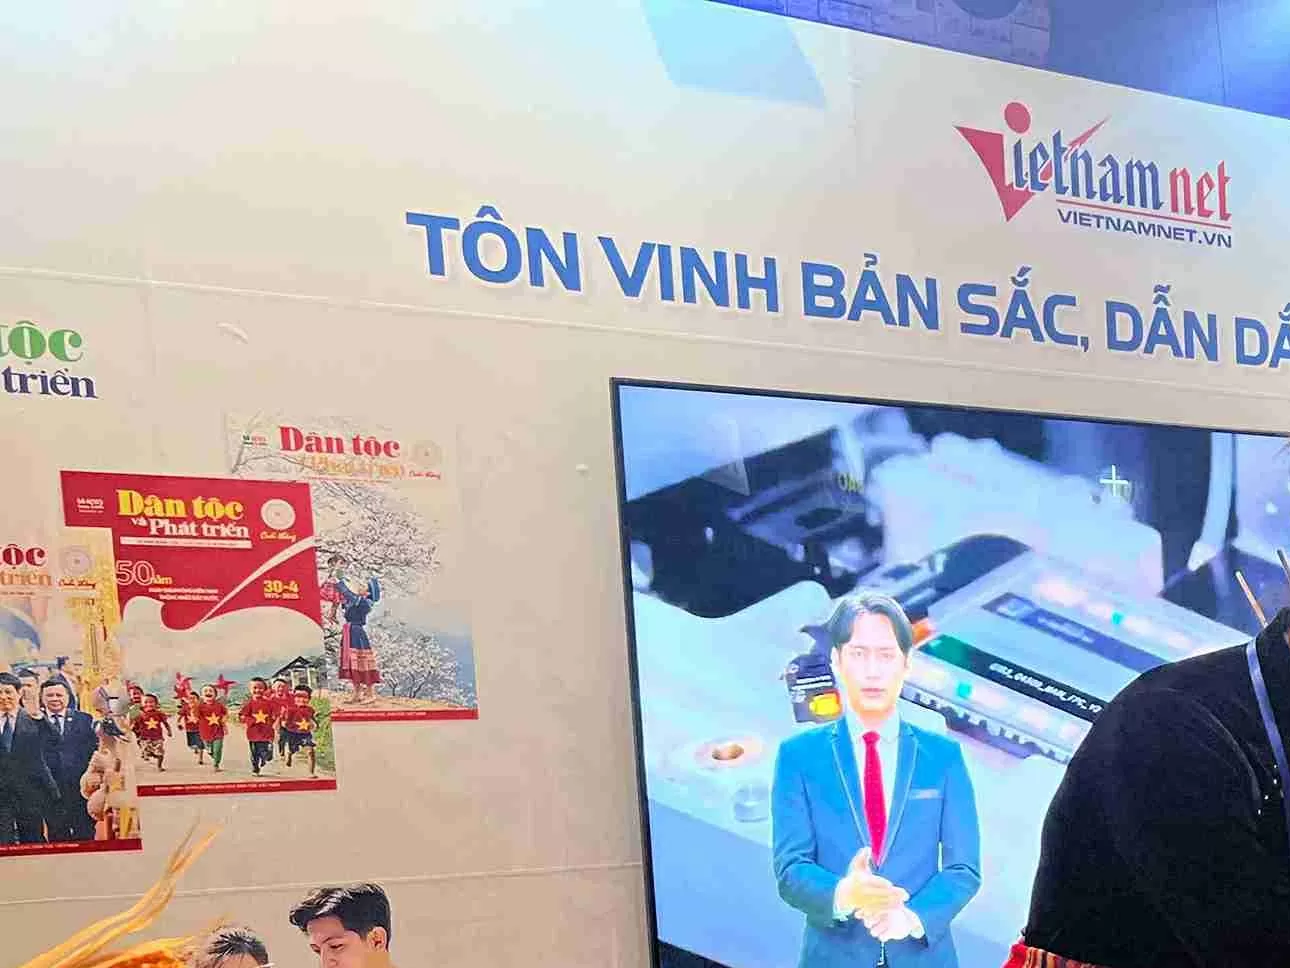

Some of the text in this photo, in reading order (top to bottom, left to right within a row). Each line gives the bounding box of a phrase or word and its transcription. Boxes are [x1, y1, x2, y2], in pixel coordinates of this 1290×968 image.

[1056, 207, 1232, 249] VIETNAMNET.VN
[404, 204, 582, 293] TÔN
[597, 235, 779, 313] VINH
[800, 252, 940, 331] BẢN
[958, 265, 1089, 353] SẮC,
[1104, 283, 1218, 362] DẪN
[1, 365, 100, 399] triển
[115, 489, 187, 519] Dân
[191, 496, 245, 523] tộc
[0, 543, 46, 570] ộc
[115, 560, 154, 586] 50
